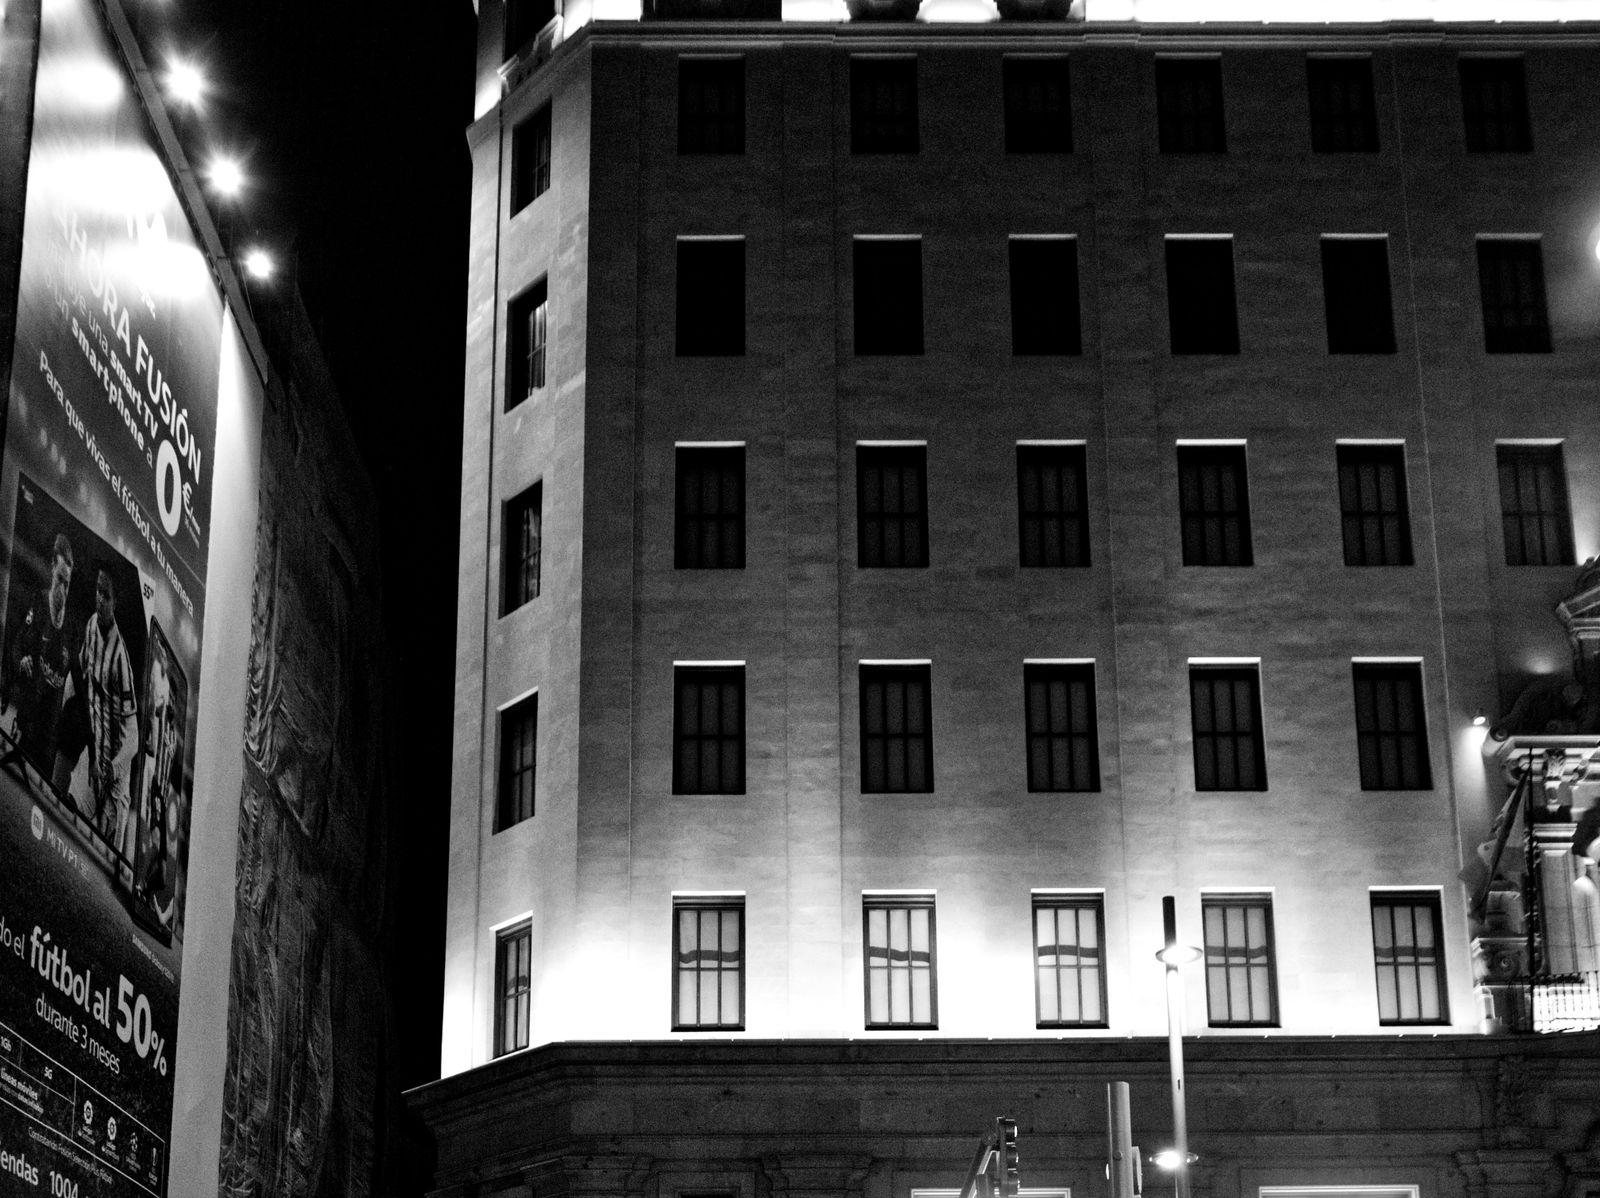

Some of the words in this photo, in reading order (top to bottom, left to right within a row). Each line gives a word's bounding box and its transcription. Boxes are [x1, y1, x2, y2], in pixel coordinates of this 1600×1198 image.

[72, 317, 145, 452] smartphone
[146, 447, 153, 469] a
[88, 310, 109, 357] una
[110, 350, 142, 415] smart
[143, 401, 158, 439] TV
[136, 334, 201, 485] FUSIÓN
[39, 350, 64, 407] Para
[65, 399, 85, 440] que
[86, 429, 111, 481] vivas
[111, 473, 121, 498] el
[122, 485, 150, 543] fútbol
[150, 535, 157, 555] a
[157, 542, 166, 570] tu
[165, 560, 194, 619] manera
[14, 933, 26, 960] el
[30, 925, 92, 1014] fútbol
[92, 986, 111, 1030] al
[116, 973, 168, 1078] 50%
[35, 992, 80, 1044] durante
[80, 1024, 89, 1049] 3
[89, 1037, 121, 1075] meses
[0, 1148, 39, 1187] endas
